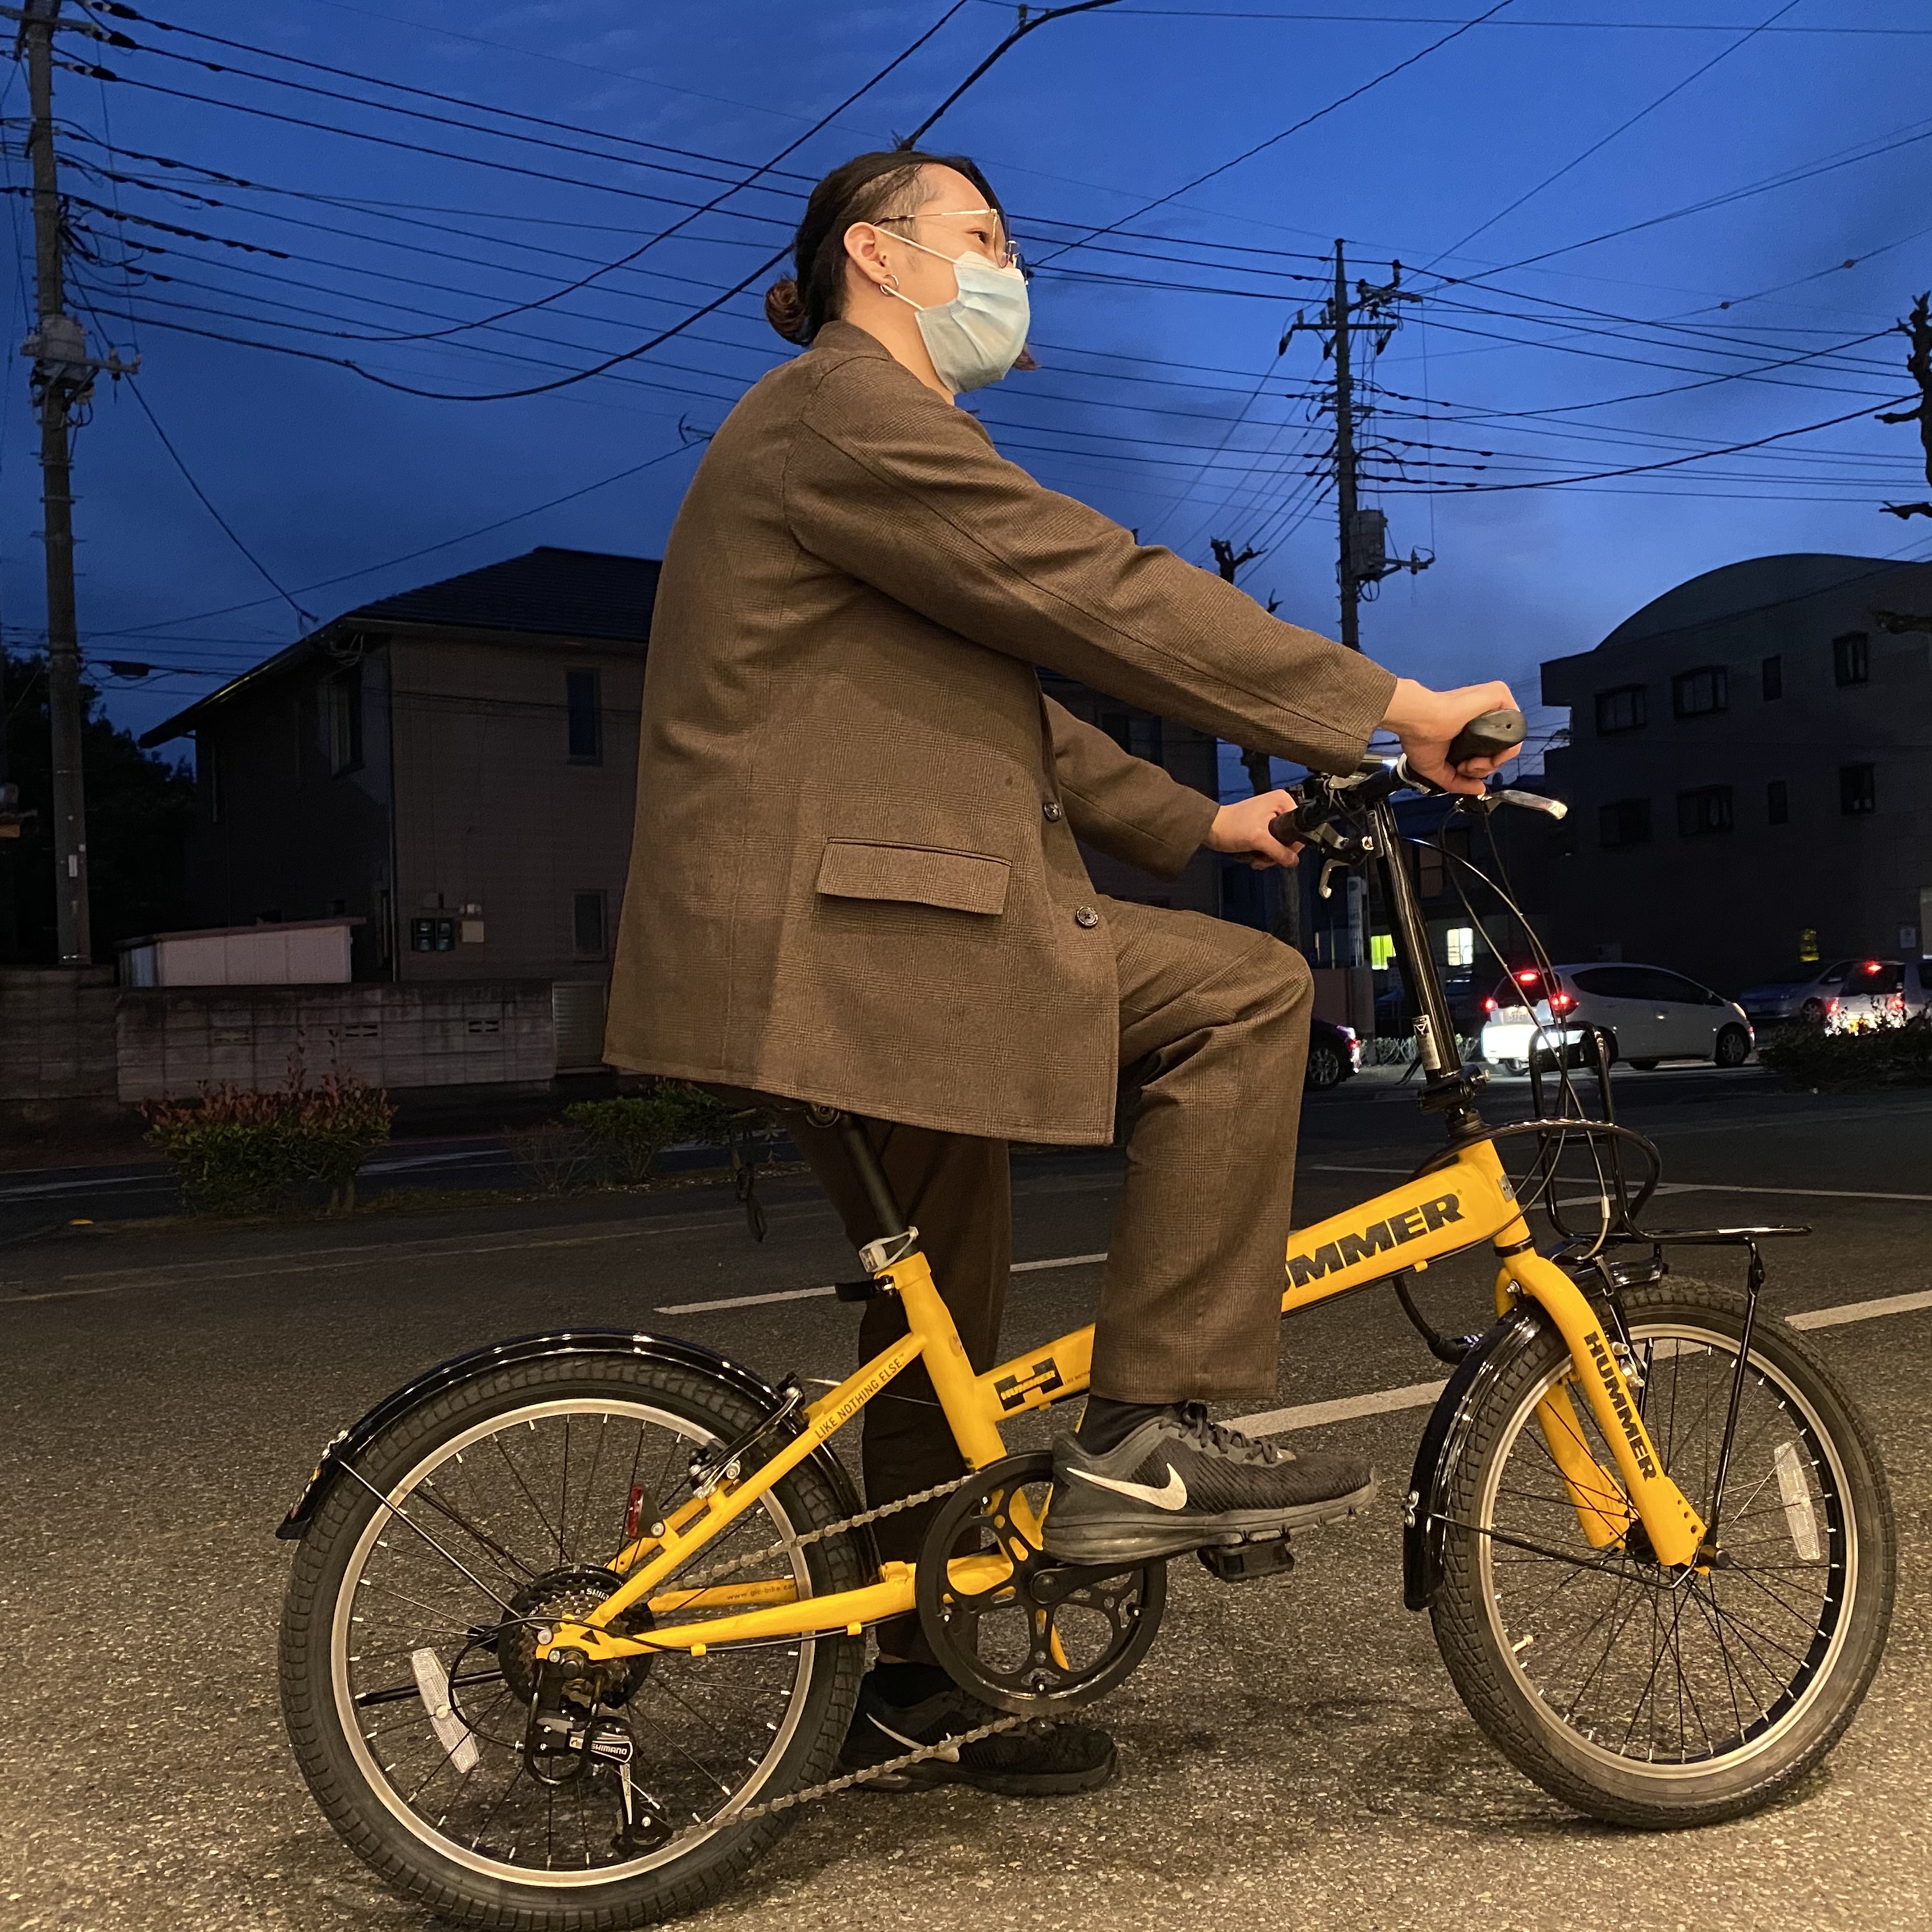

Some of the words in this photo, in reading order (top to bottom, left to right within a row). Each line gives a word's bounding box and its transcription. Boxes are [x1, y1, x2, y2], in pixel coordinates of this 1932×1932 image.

[1281, 1193, 1466, 1293] MMER
[815, 1416, 838, 1439] LIKE
[836, 1379, 880, 1420] NOTHING
[1584, 1330, 1657, 1482] HUMMER
[590, 1743, 628, 1756] SHIMANO
